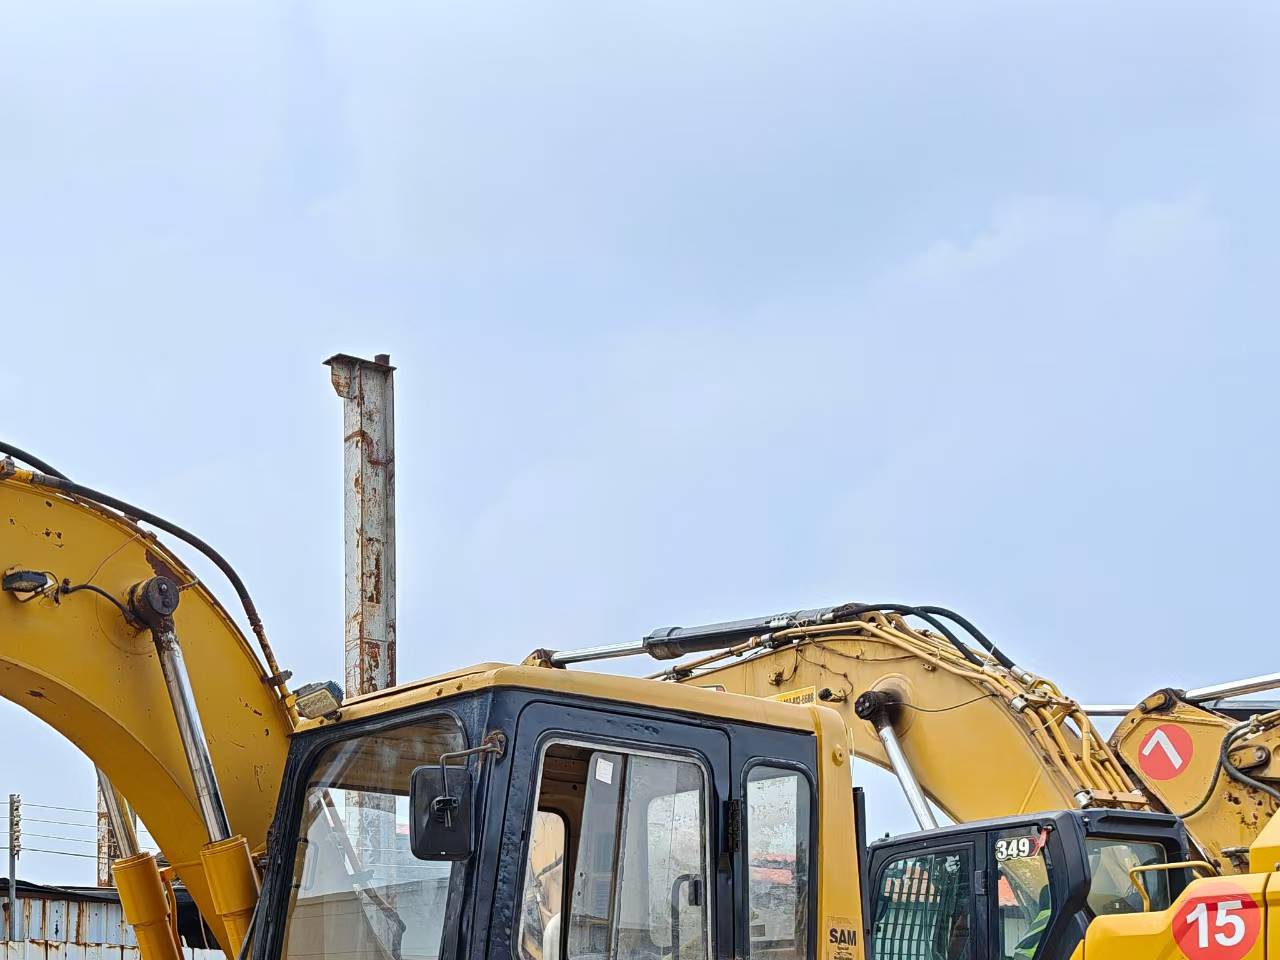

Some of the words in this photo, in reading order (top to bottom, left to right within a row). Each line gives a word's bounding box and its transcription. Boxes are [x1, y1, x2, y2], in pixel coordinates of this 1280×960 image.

[996, 837, 1030, 859] 349
[1186, 900, 1246, 949] 15
[829, 928, 857, 947] SAM
